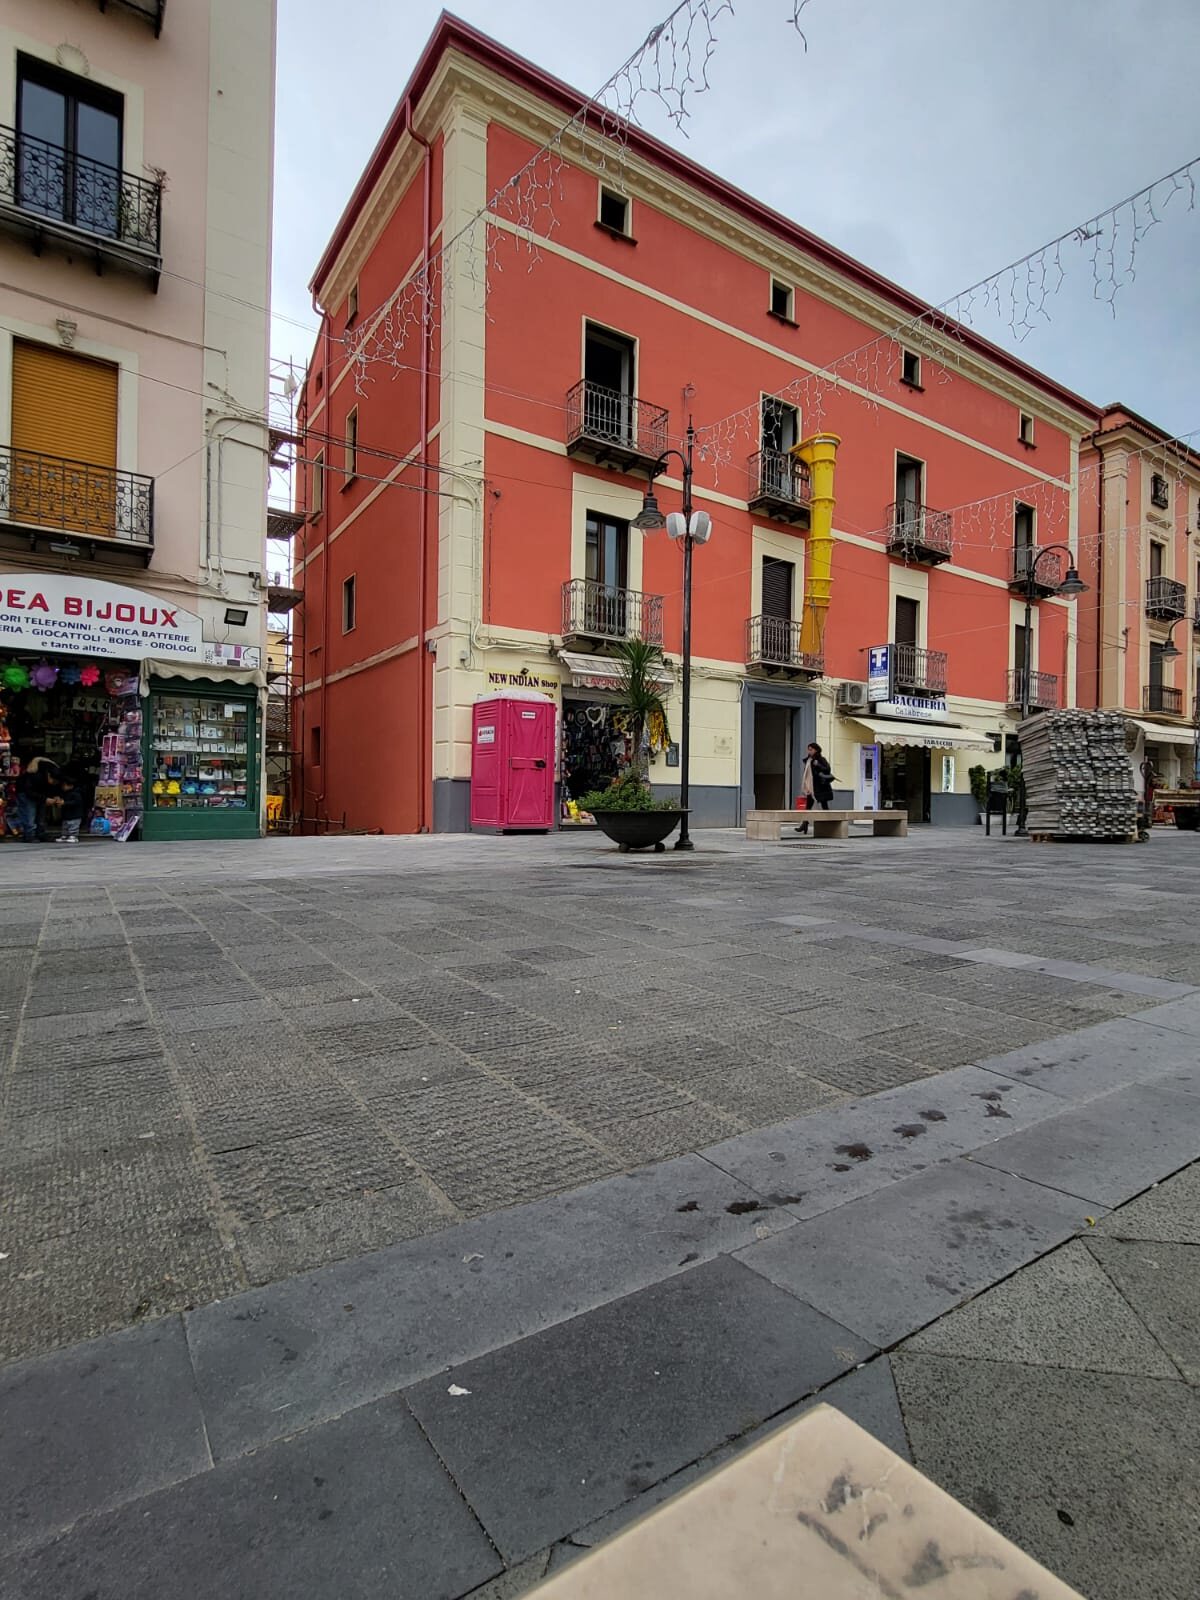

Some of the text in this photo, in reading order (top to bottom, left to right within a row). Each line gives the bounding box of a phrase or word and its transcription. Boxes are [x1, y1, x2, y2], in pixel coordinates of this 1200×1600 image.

[0, 589, 178, 628] EA BIJOUX
[24, 616, 91, 631] TELEFONINI
[99, 625, 139, 636] CARICA
[142, 630, 190, 643] BATTERIE
[32, 628, 100, 643] GIOCATTOLI
[109, 636, 143, 647] BORSE
[150, 641, 197, 653] OROLOGI
[51, 641, 80, 650] tanto
[489, 672, 558, 689] NEW INDIAN Shop
[888, 695, 947, 711] BACCHERIA
